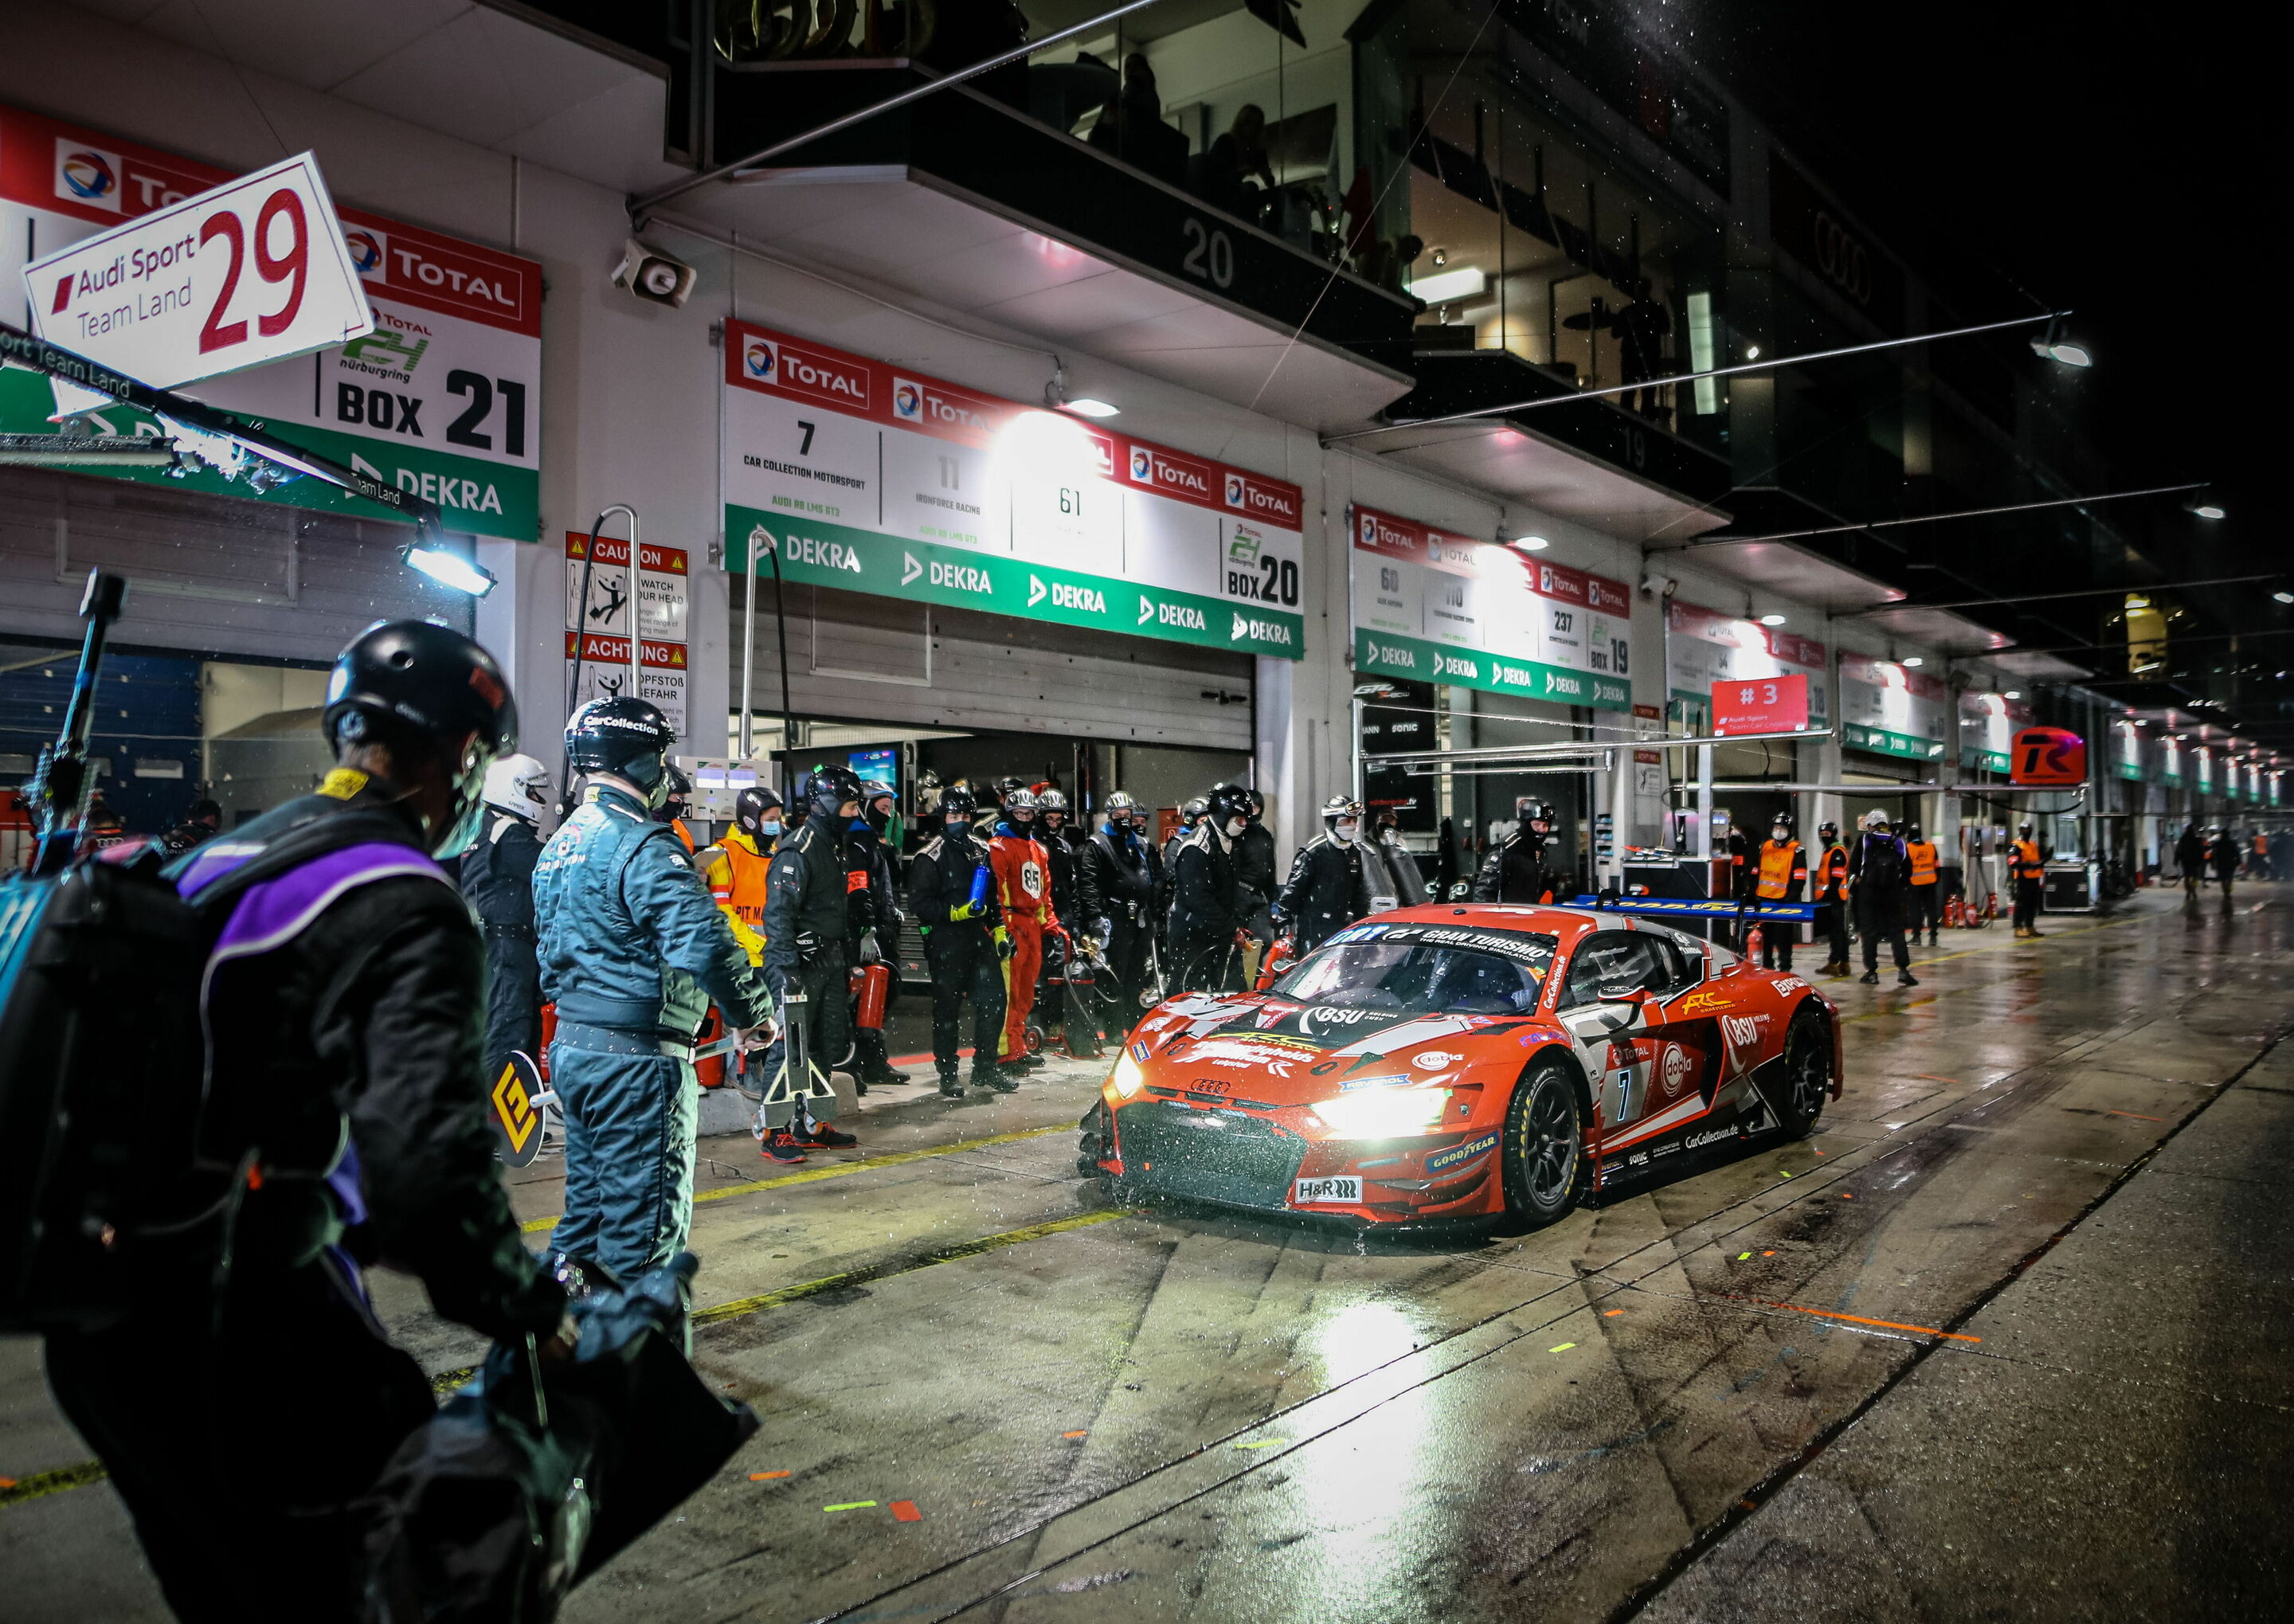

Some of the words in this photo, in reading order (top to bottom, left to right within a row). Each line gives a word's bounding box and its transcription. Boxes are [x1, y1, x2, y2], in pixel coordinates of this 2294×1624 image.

[1183, 217, 1233, 288] 20
[77, 255, 125, 299] Audi
[131, 233, 195, 282] Sport
[199, 189, 309, 355] 29
[393, 248, 515, 308] TOTAL
[77, 304, 131, 346] Team
[139, 276, 191, 321] Land
[384, 314, 433, 336] TOTAL
[38, 339, 84, 380] Team
[88, 364, 130, 398] Land
[339, 358, 411, 384] nürburgring
[782, 355, 865, 399] TOTAL
[338, 382, 424, 438] BOX
[446, 369, 526, 458] 21
[926, 396, 996, 434] TOTAL
[797, 421, 816, 456] 7
[744, 455, 761, 468] CAR
[763, 460, 812, 479] COLLECTION
[814, 470, 866, 491] MOTORSPORT
[937, 454, 961, 491] 11
[1154, 460, 1208, 492] TOTAL
[378, 483, 401, 506] Land
[397, 468, 503, 515] DEKRA
[772, 494, 792, 508] AUDI
[806, 500, 824, 515] LMS
[915, 493, 955, 511] IRONFORCE
[956, 502, 981, 516] RACING
[1059, 487, 1081, 517] 61
[1247, 487, 1294, 515] TOTAL
[1378, 526, 1415, 549] TOTAL
[595, 542, 662, 566] CAUON
[786, 535, 861, 573] DEKRA
[640, 579, 674, 592] WATCH
[930, 561, 992, 595] DEKRA
[1227, 571, 1259, 601] BOX
[1260, 554, 1299, 608] 20
[1381, 567, 1399, 593] 60
[1553, 577, 1580, 595] TOTAL
[639, 590, 656, 601] OUR
[658, 593, 684, 605] HEAD
[1051, 583, 1106, 614] DEKRA
[1600, 590, 1624, 607] TOTAL
[1158, 604, 1206, 632] DEKRA
[1554, 611, 1572, 633] 237
[1249, 620, 1292, 646] DEKRA
[1382, 646, 1415, 668] DEKRA
[1446, 656, 1478, 679] DEKRA
[1591, 652, 1607, 671] BOX
[1611, 638, 1628, 675] 19
[1503, 667, 1532, 687] DEKRA
[1556, 676, 1580, 695] DEKRA
[1603, 687, 1624, 702] DEKRA
[1740, 688, 1755, 705] #
[1763, 684, 1777, 705] 3
[584, 716, 659, 736] CarCollection
[1024, 870, 1039, 891] 85
[736, 906, 750, 920] PIT
[1423, 929, 1470, 945] GRAN
[1471, 934, 1548, 959] TURISMO
[1455, 941, 1488, 951] DRIVING
[1488, 946, 1536, 963] SIMULATOR
[1544, 955, 1567, 1009] CarCollection.de
[1316, 1007, 1367, 1024] BSU
[1700, 1003, 1736, 1014] BRATISLAVA
[1731, 1017, 1757, 1046] BSU
[1422, 1053, 1464, 1063] dobla
[1623, 1046, 1649, 1059] TOTAL
[1666, 1058, 1693, 1077] dobla
[1617, 1070, 1630, 1121] 7
[1685, 1125, 1739, 1149] CarCollection.de
[1434, 1137, 1496, 1168] GOODYEAR
[1299, 1180, 1333, 1198] H&R
